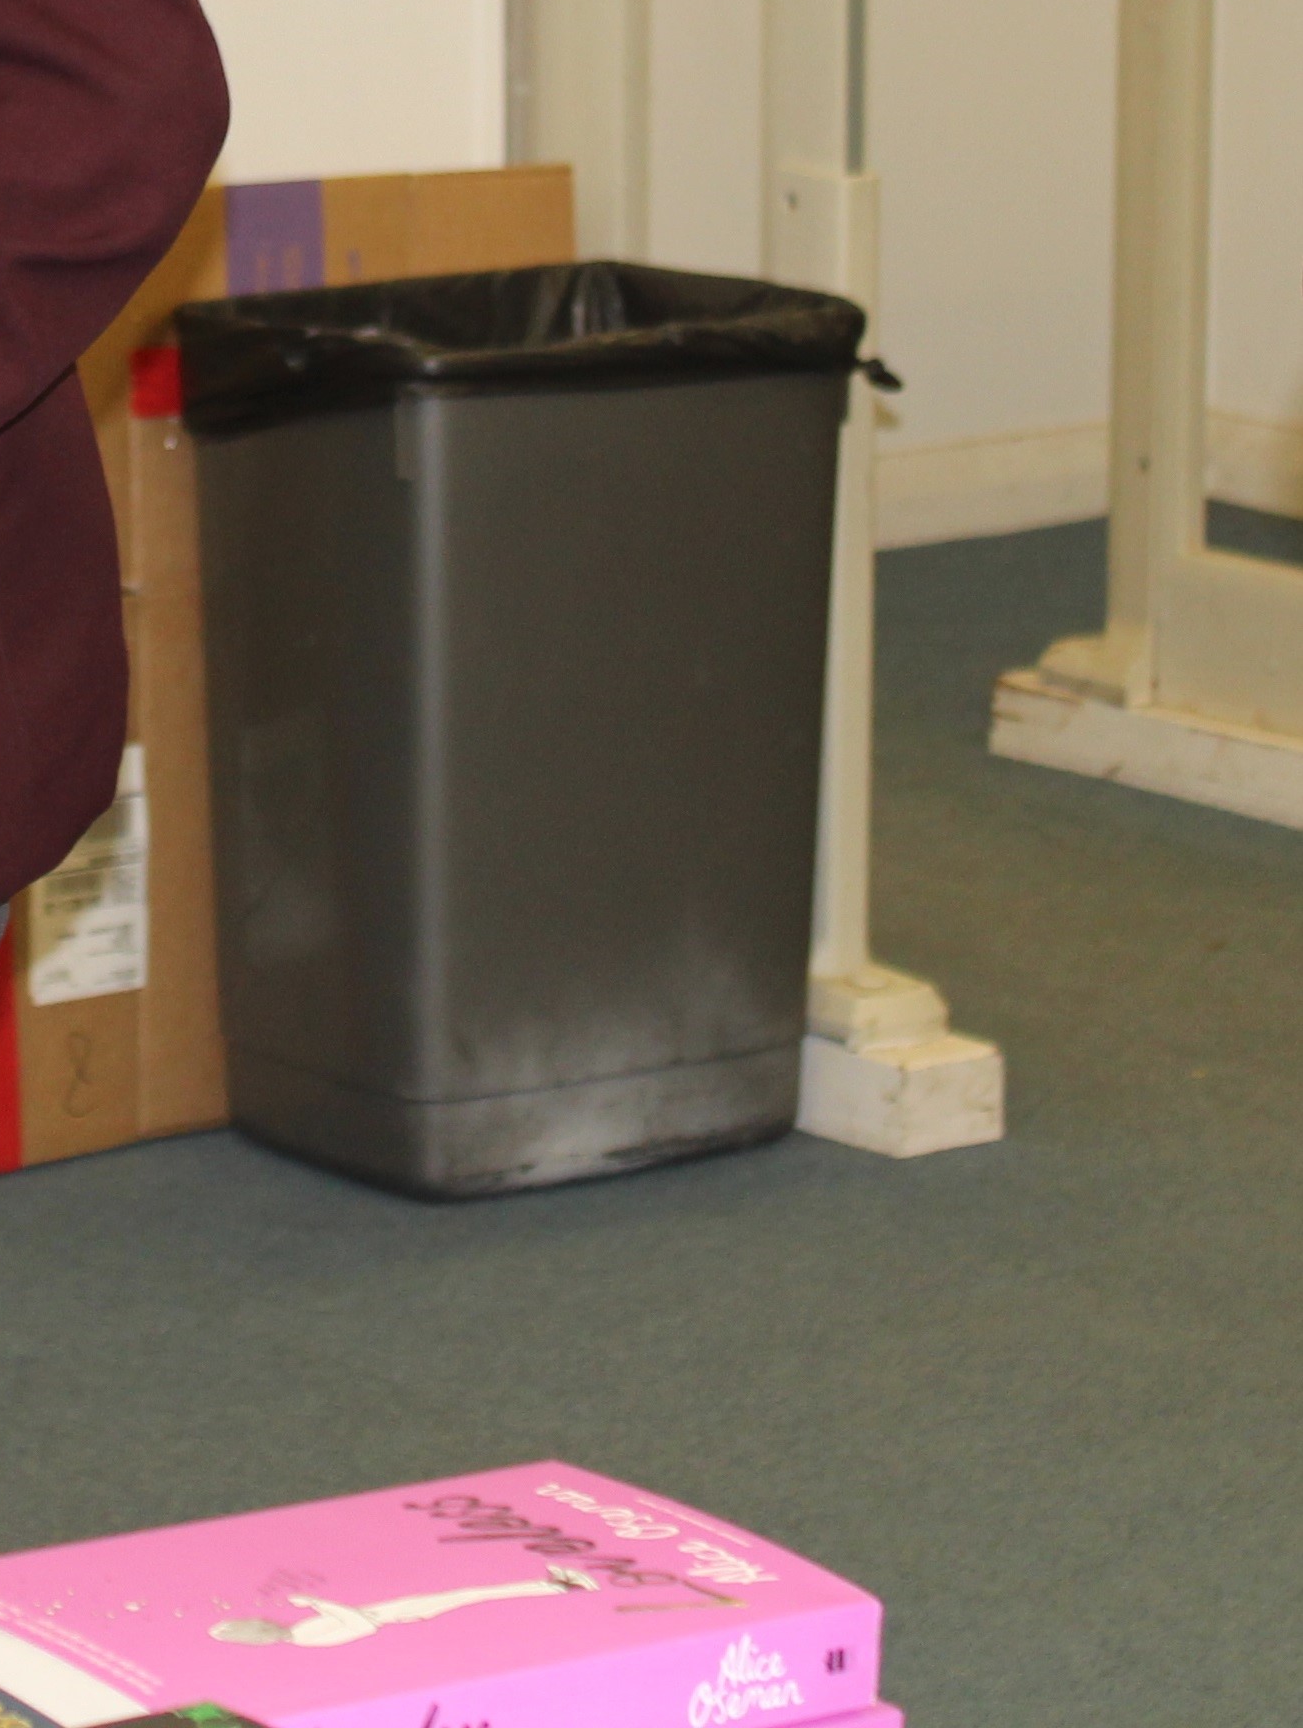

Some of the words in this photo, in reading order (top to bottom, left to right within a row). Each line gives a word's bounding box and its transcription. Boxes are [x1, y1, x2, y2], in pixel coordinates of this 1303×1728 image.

[679, 1539, 780, 1585] Alice
[717, 1633, 787, 1688] Alice
[689, 1680, 804, 1728] Oseman
